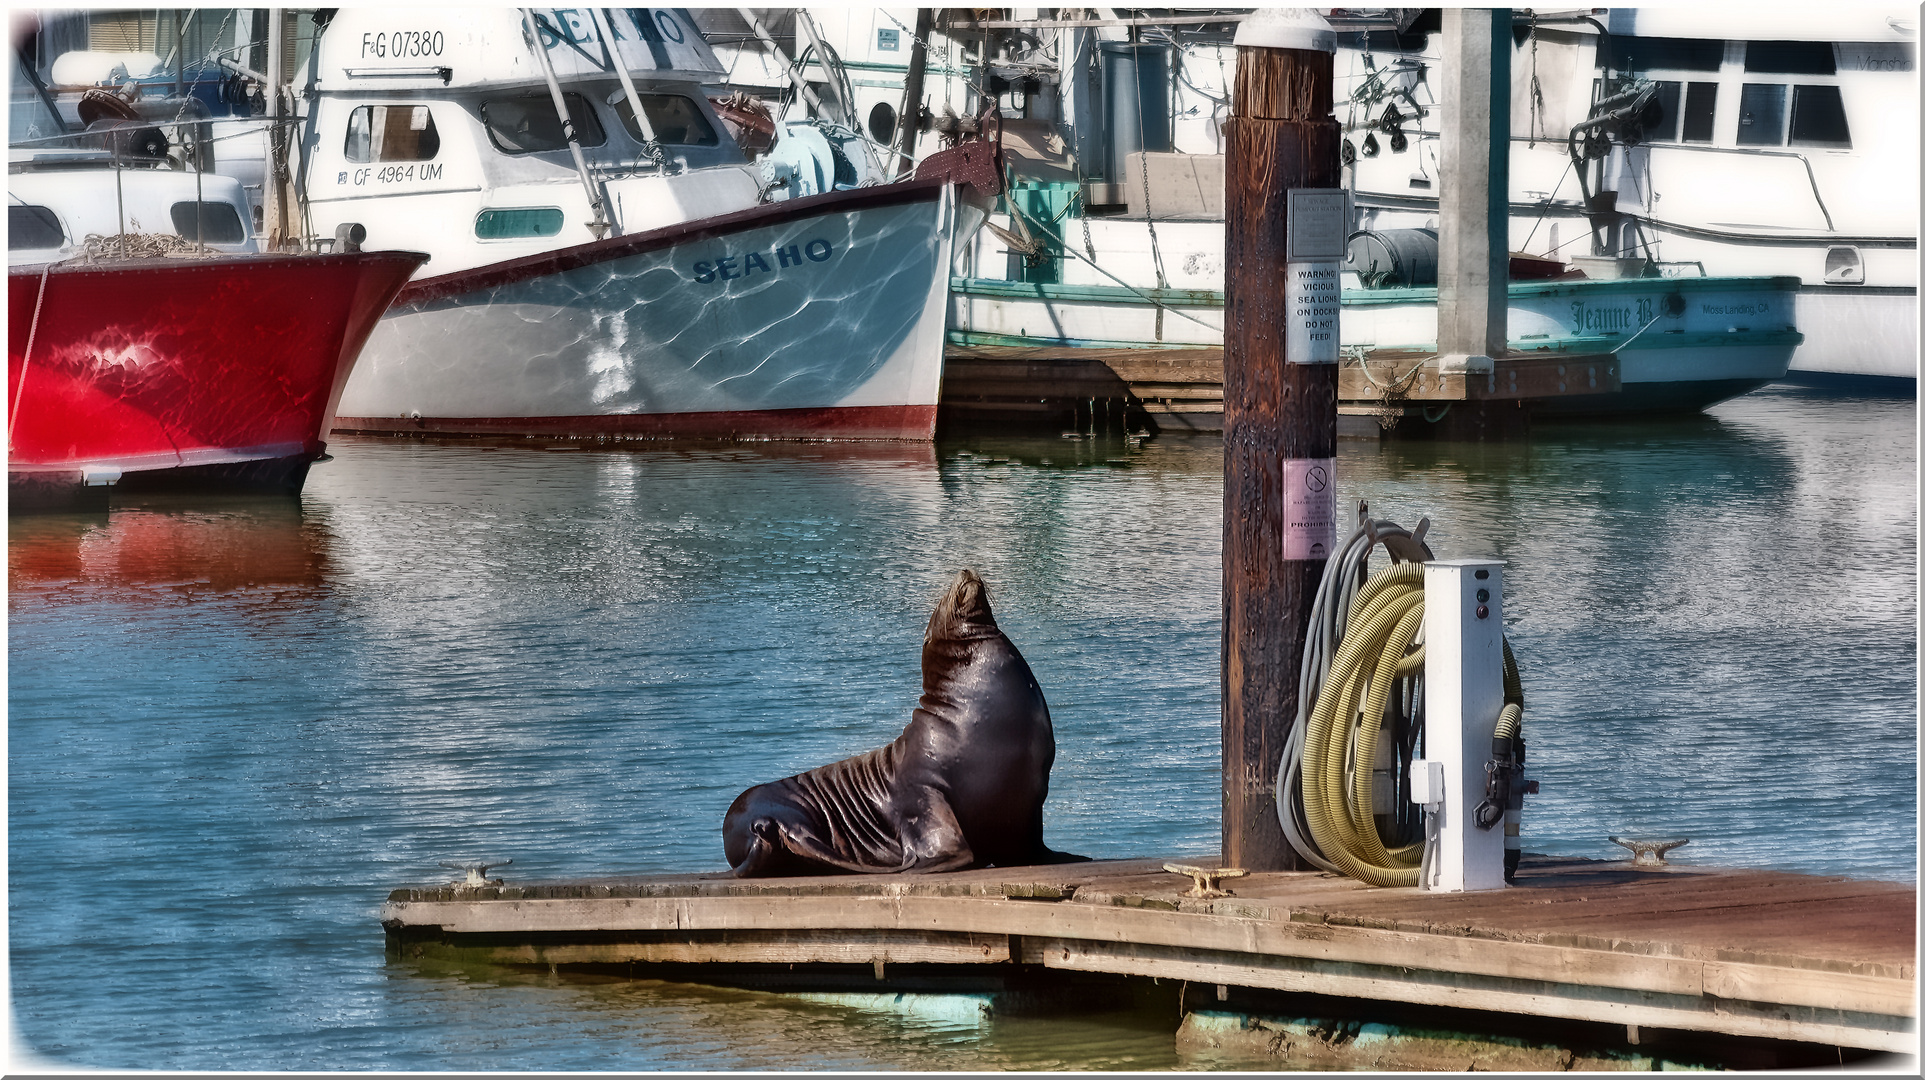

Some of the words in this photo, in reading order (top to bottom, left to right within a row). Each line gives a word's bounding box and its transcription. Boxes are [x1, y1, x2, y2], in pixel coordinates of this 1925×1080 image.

[362, 32, 386, 58] F&G
[392, 30, 444, 57] 07380
[354, 168, 371, 186] CF
[377, 165, 414, 183] 4964
[419, 163, 443, 180] UM
[693, 251, 772, 284] SEA
[776, 239, 833, 268] HO
[1303, 283, 1334, 291] VICIOUS
[1297, 296, 1316, 304] SEA
[1317, 295, 1337, 303] LIONS
[1296, 308, 1311, 316] ON
[1702, 304, 1724, 315] Moss
[1725, 304, 1757, 316] Landing,
[1757, 303, 1770, 314] CA
[1571, 301, 1631, 336] Jeanne
[1636, 298, 1654, 328] B
[1305, 321, 1318, 329] DO
[1320, 320, 1333, 328] NOT
